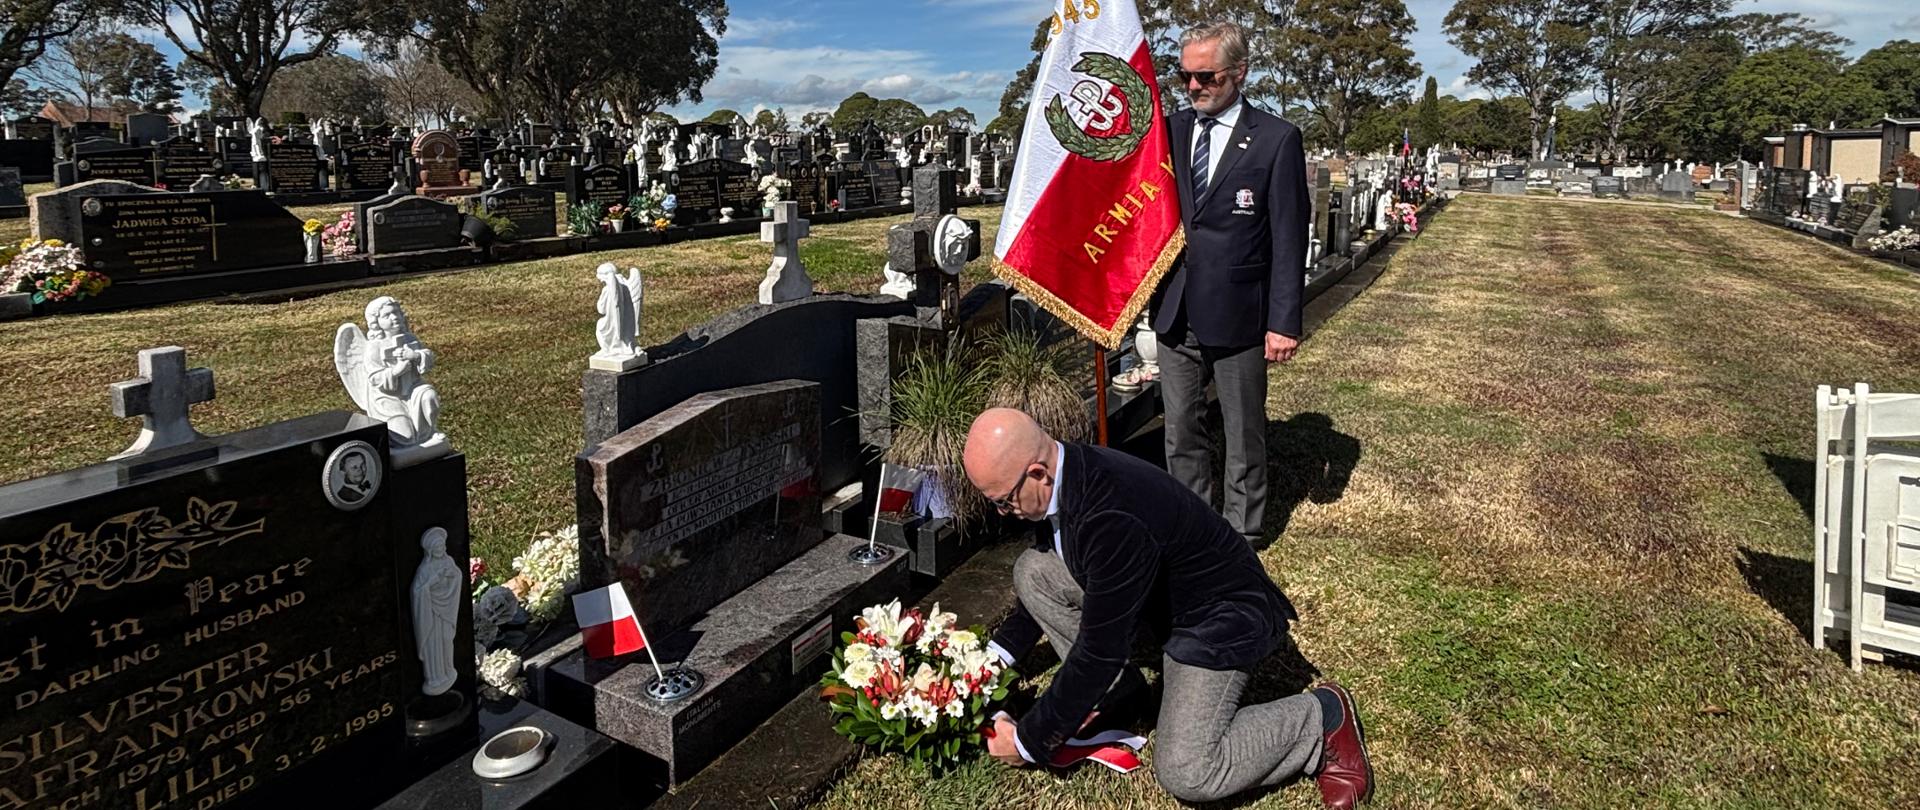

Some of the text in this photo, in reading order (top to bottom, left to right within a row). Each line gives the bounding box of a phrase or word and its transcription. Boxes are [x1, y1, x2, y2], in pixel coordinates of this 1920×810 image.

[112, 215, 207, 229] JADWIGA SZYDA
[1083, 178, 1160, 264] ARMIA
[15, 590, 306, 710] DARLING HUSBAND
[90, 615, 145, 648] in
[0, 641, 271, 775] SILVESTER
[200, 710, 267, 753] AGED
[279, 689, 312, 714] 56
[324, 649, 398, 691] YEARS
[135, 733, 264, 810] LILLY
[197, 774, 256, 810] DIED
